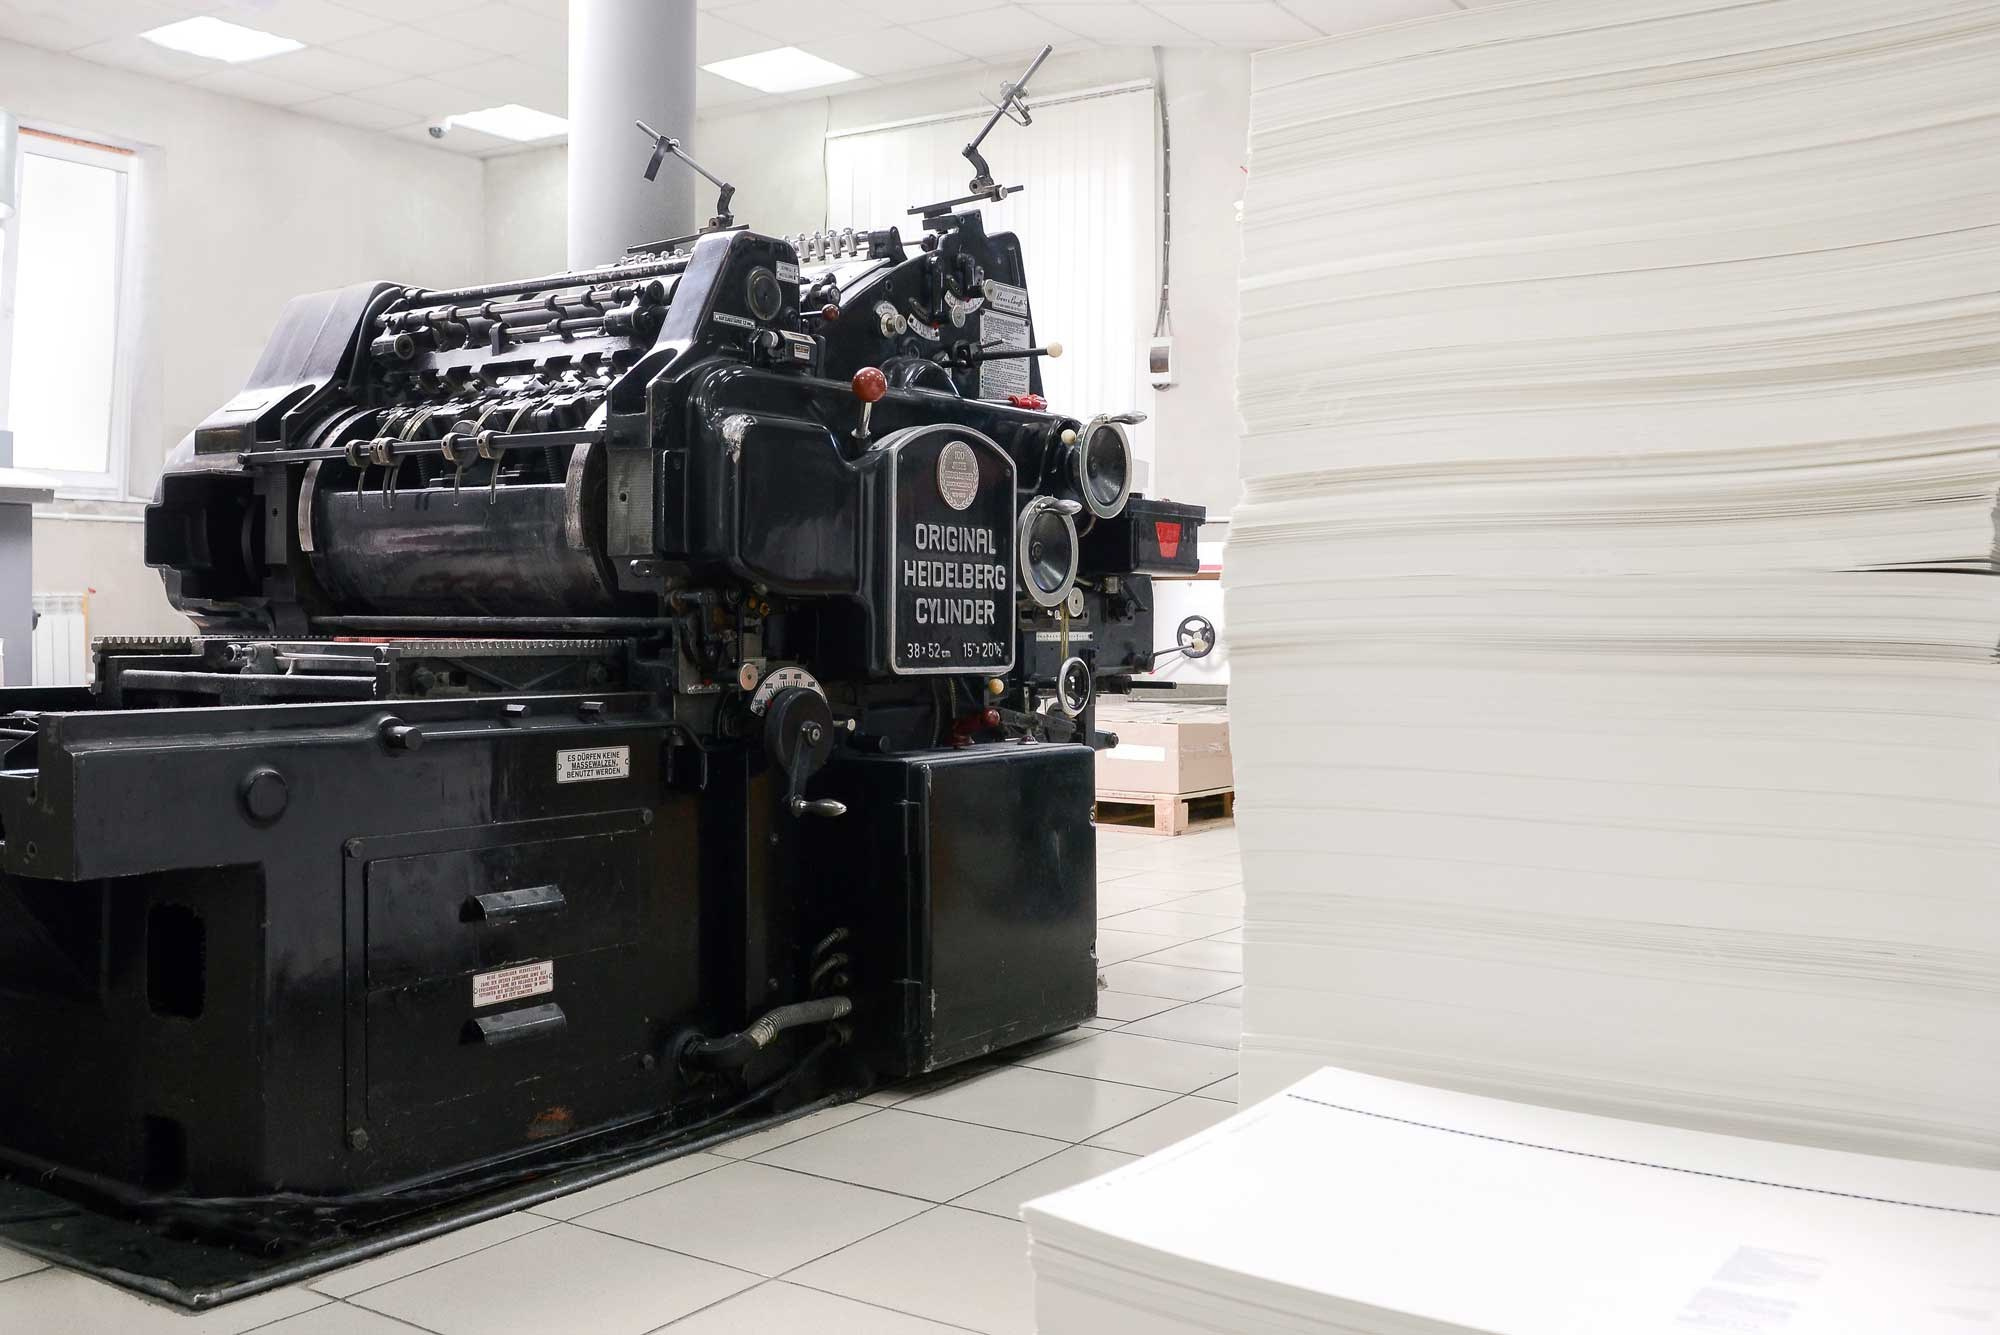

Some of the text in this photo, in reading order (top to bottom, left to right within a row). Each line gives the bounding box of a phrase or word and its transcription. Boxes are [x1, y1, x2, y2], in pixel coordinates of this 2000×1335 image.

[915, 523, 997, 554] ORIGINAL
[903, 559, 1006, 590] HEIDELBERG
[915, 597, 995, 625] CYLINDER
[567, 751, 620, 762] ES DÜRFEN KEINE
[566, 767, 621, 778] BENUTZT WERDEN
